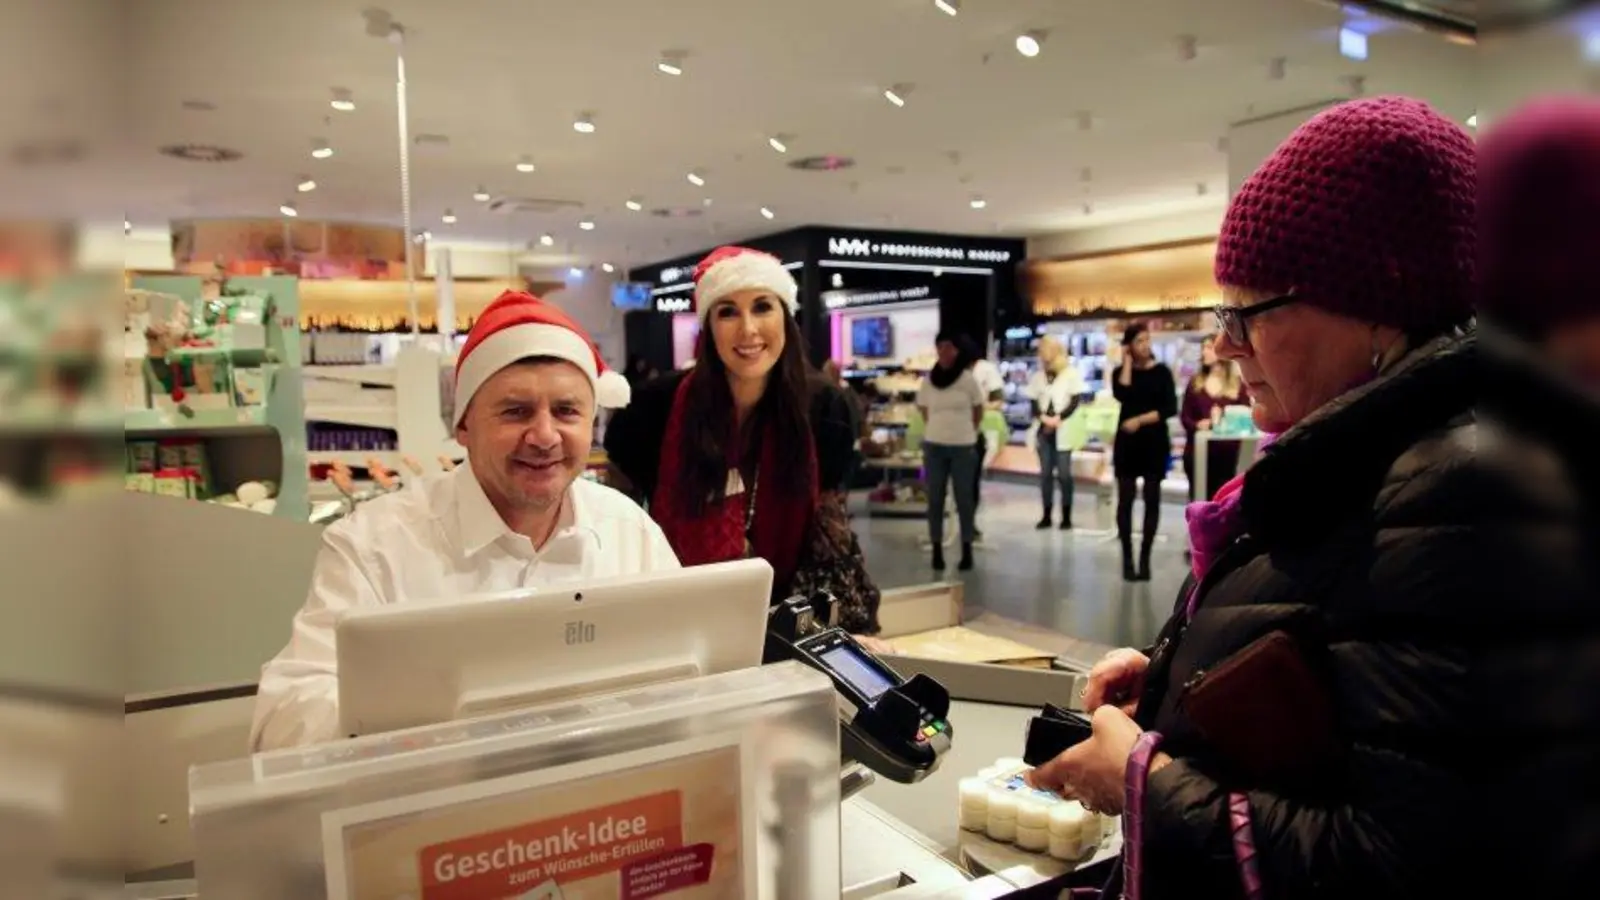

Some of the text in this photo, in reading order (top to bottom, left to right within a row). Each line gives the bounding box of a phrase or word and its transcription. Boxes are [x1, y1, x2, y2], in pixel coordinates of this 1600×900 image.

[829, 237, 871, 256] NYX
[881, 243, 964, 260] PROFESSIONAL
[434, 814, 647, 882] Geschenk-Idee
[508, 836, 665, 885] zum Wünsche-Erfüllen
